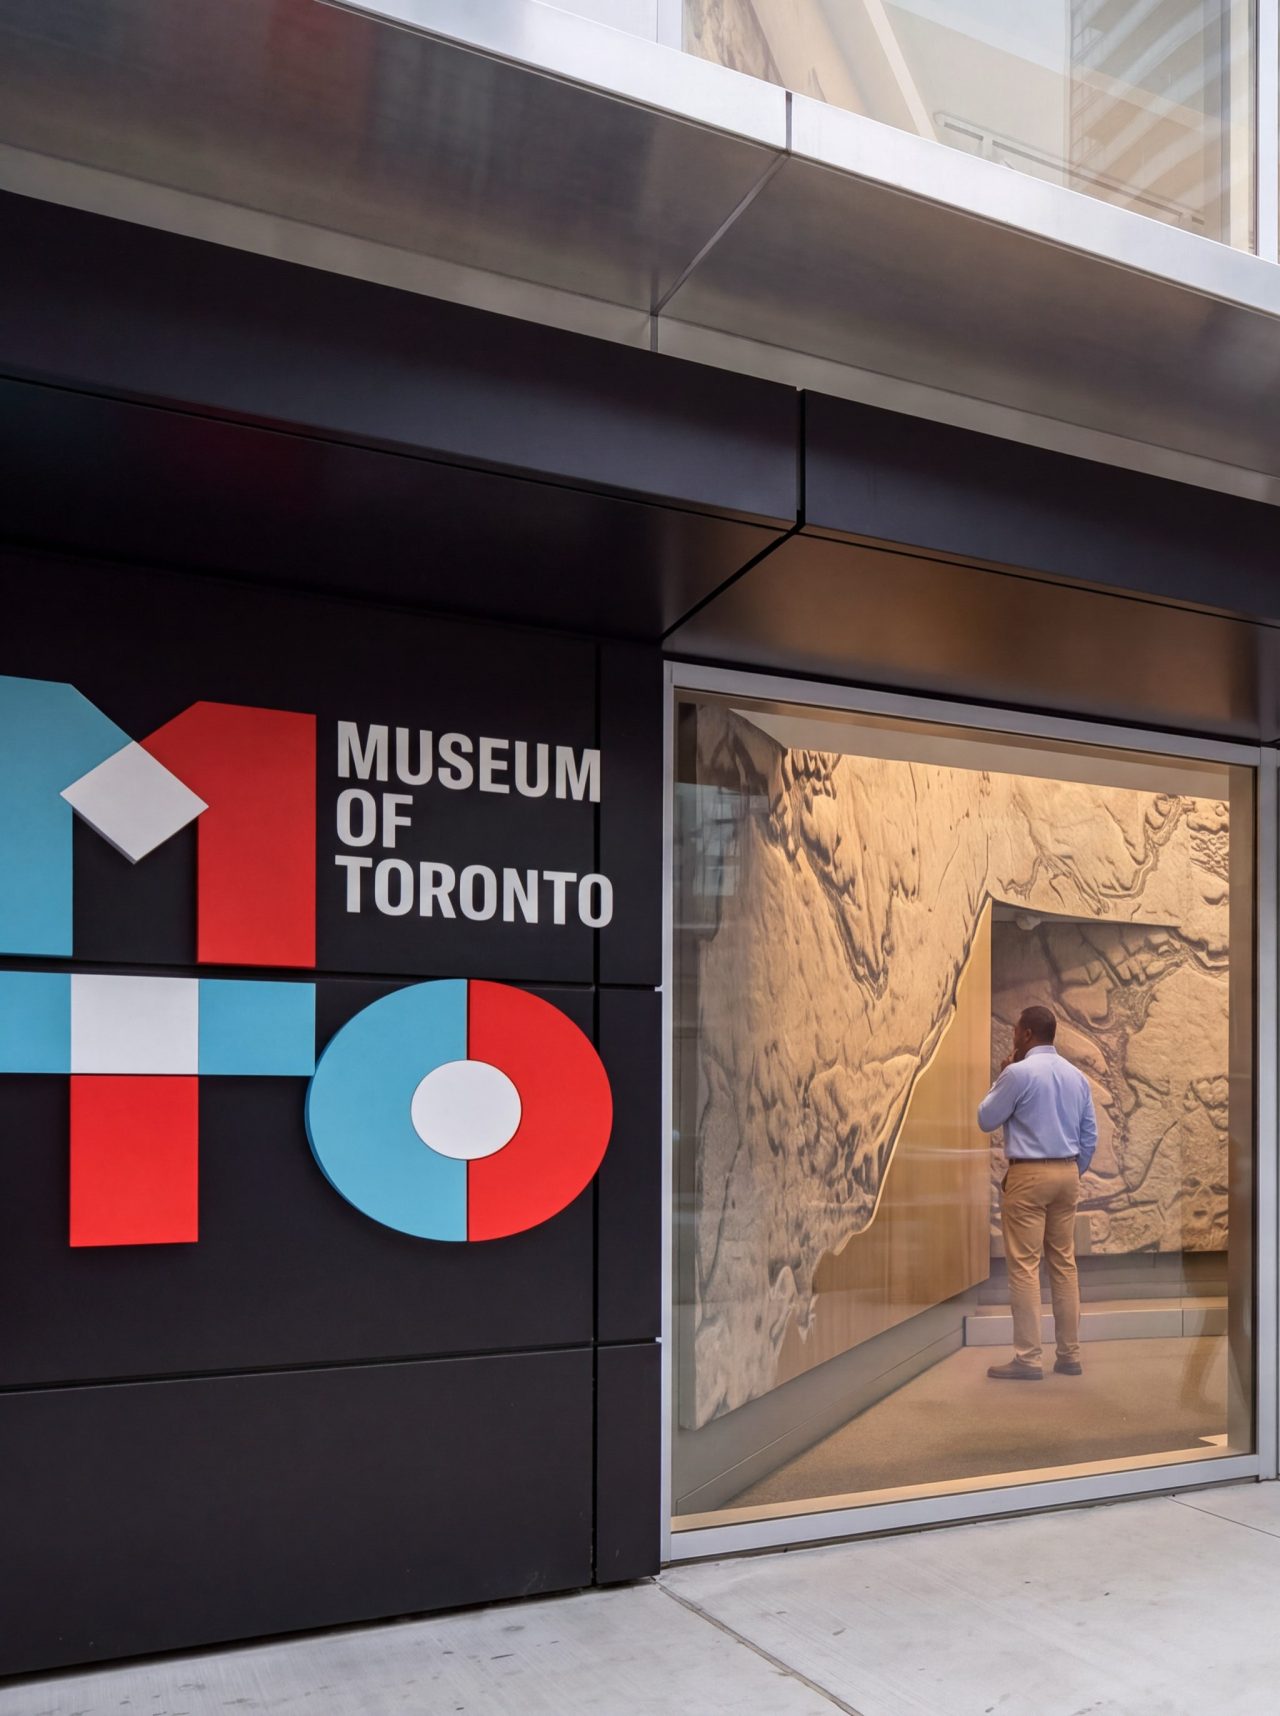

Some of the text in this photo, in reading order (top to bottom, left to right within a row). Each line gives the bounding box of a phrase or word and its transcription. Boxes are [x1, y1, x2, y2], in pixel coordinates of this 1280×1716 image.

[337, 720, 602, 803] MUSEUM
[336, 788, 413, 848] OF
[335, 855, 614, 928] TORONTO
